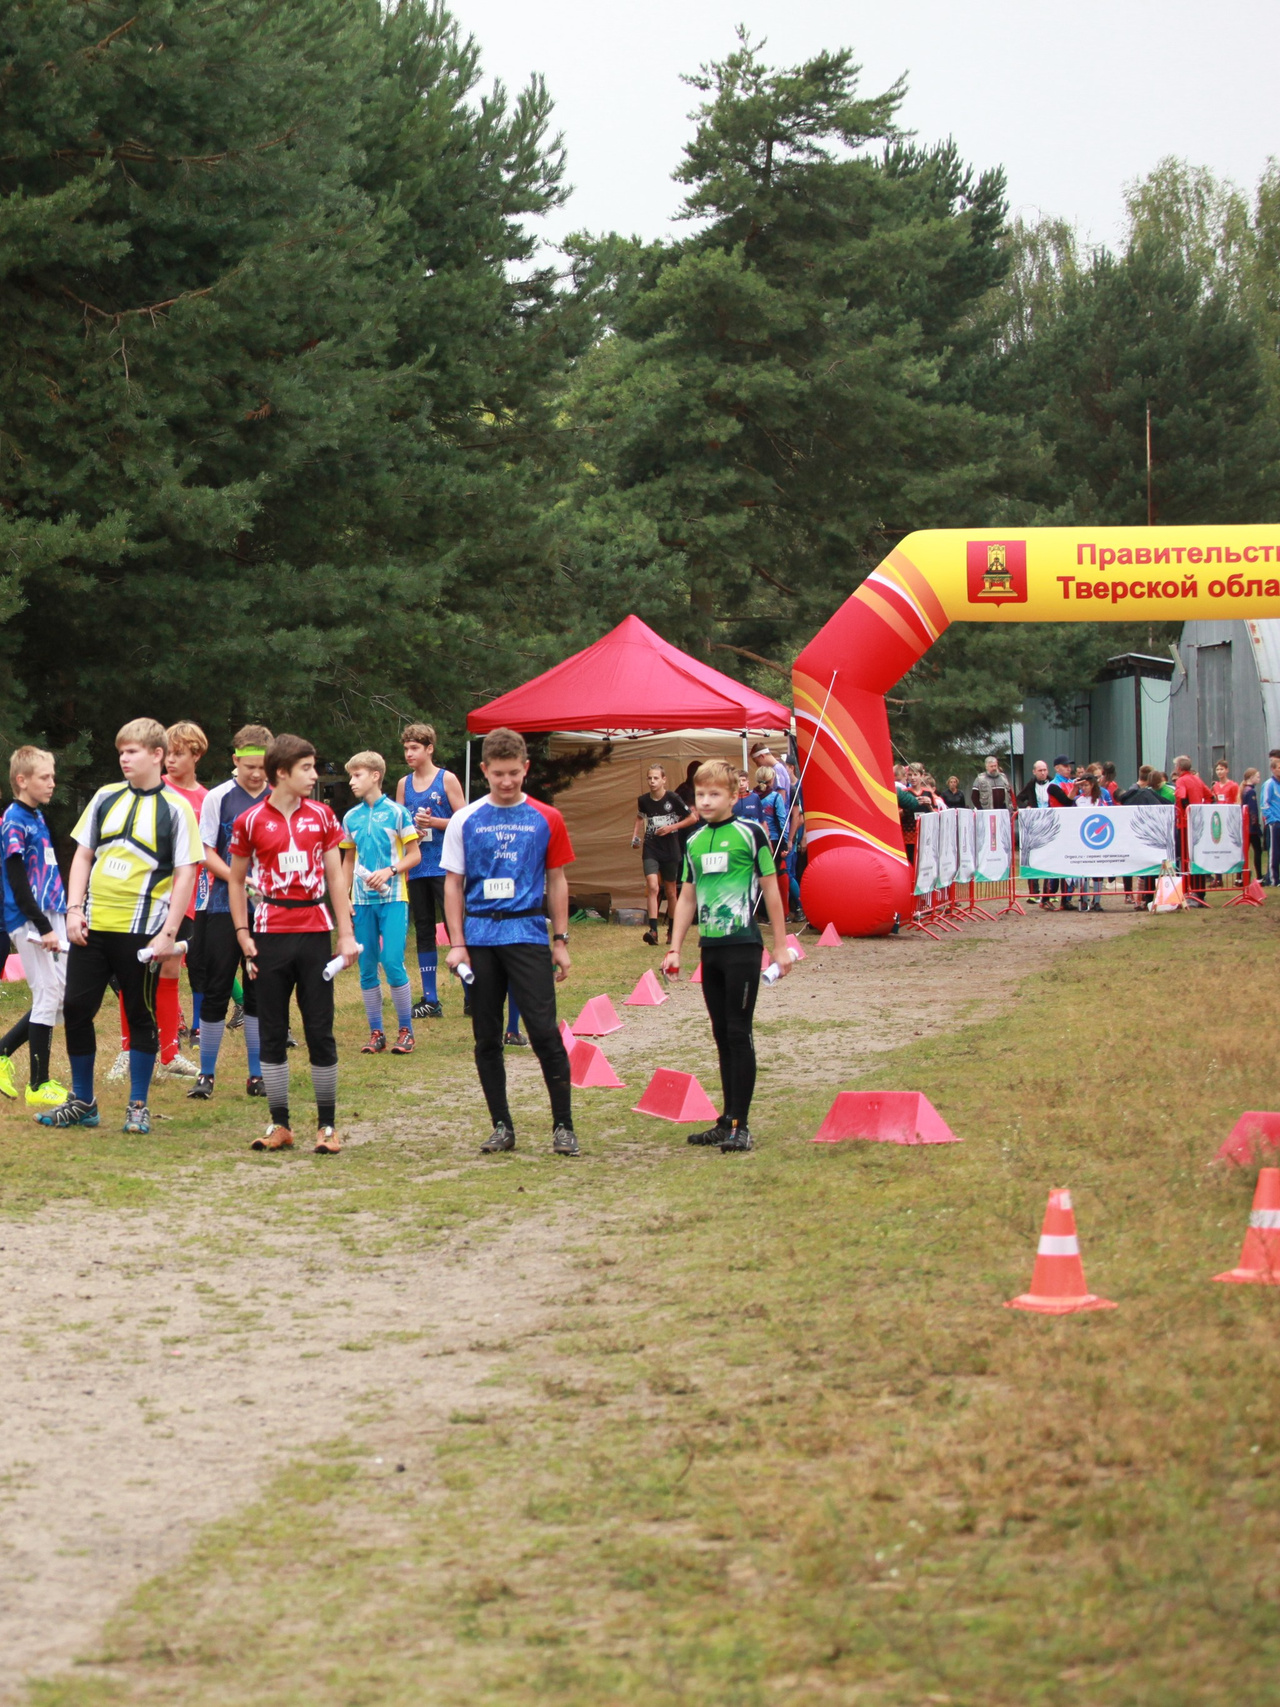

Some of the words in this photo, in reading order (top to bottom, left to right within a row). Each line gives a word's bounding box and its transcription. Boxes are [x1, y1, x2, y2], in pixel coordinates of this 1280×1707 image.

[1077, 543, 1280, 571] Правительст
[1056, 574, 1198, 604] Тверской
[475, 824, 536, 834] ОРИЕНТИРОВАНИЕ
[495, 831, 516, 843] Way
[500, 841, 508, 850] of
[284, 855, 304, 865] 1011
[705, 856, 723, 866] 1117
[108, 860, 127, 871] 1110
[489, 882, 510, 891] 1014
